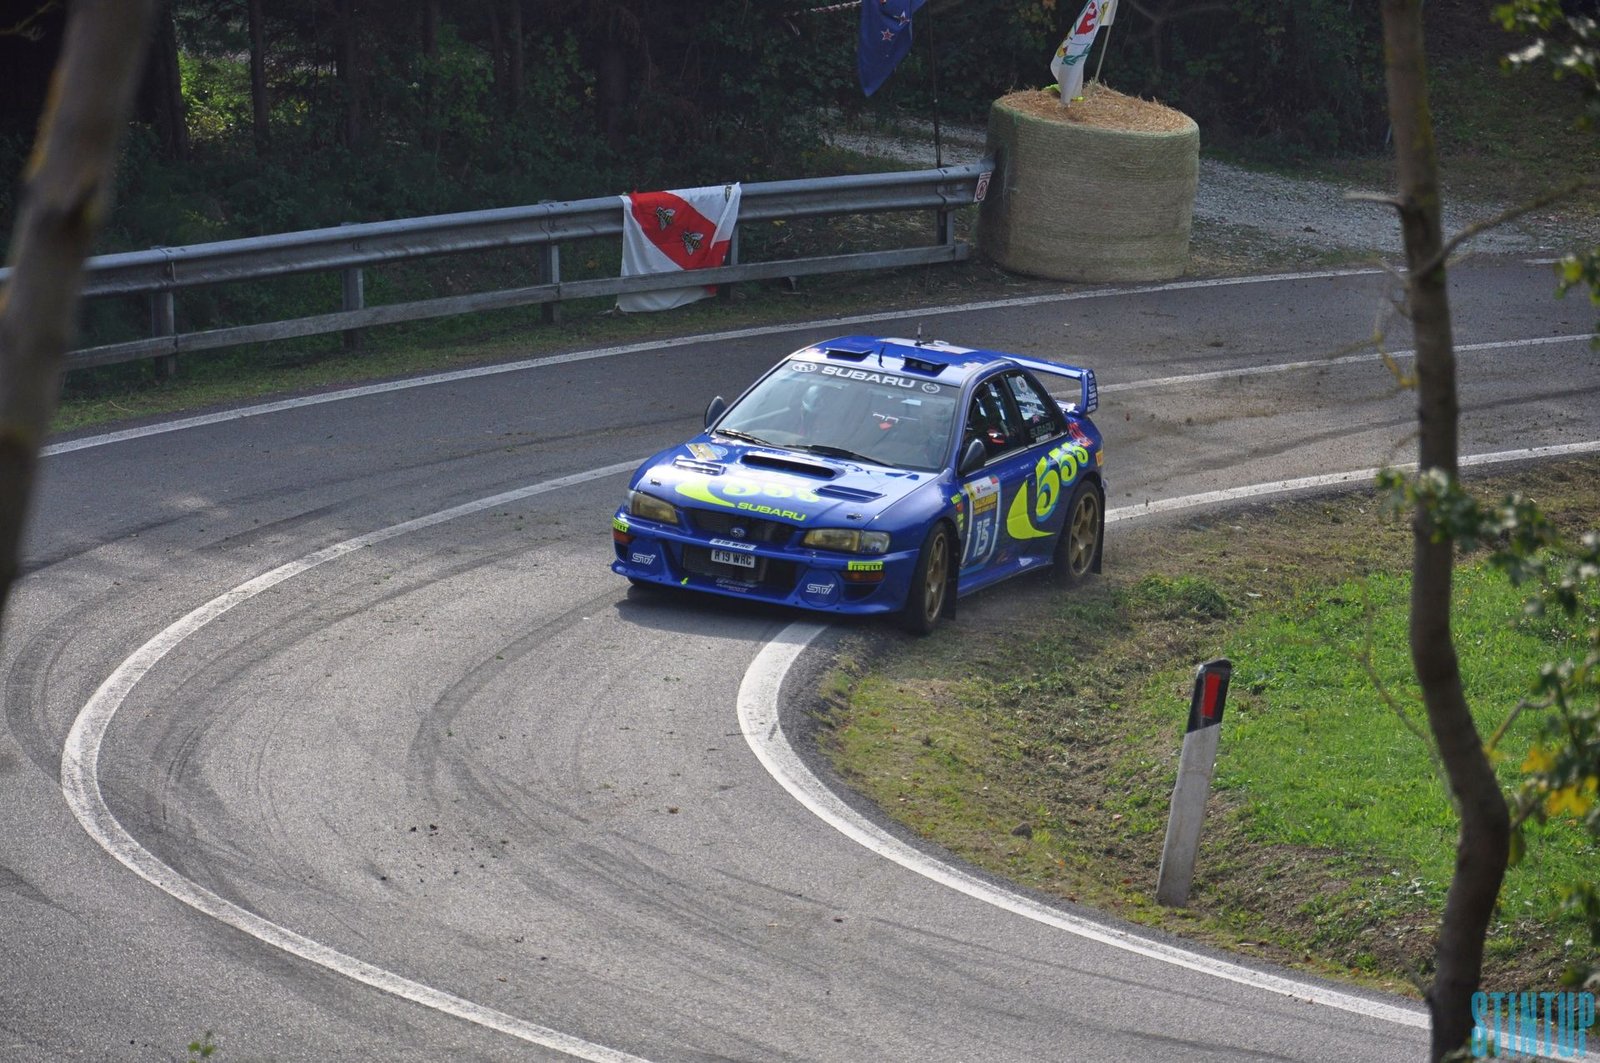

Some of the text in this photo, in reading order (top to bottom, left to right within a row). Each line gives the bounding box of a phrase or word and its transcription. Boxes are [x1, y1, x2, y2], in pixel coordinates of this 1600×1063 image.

[821, 365, 916, 389] SUBARU
[737, 502, 807, 522] SUBARU
[972, 518, 991, 557] 15
[732, 552, 752, 566] WRC
